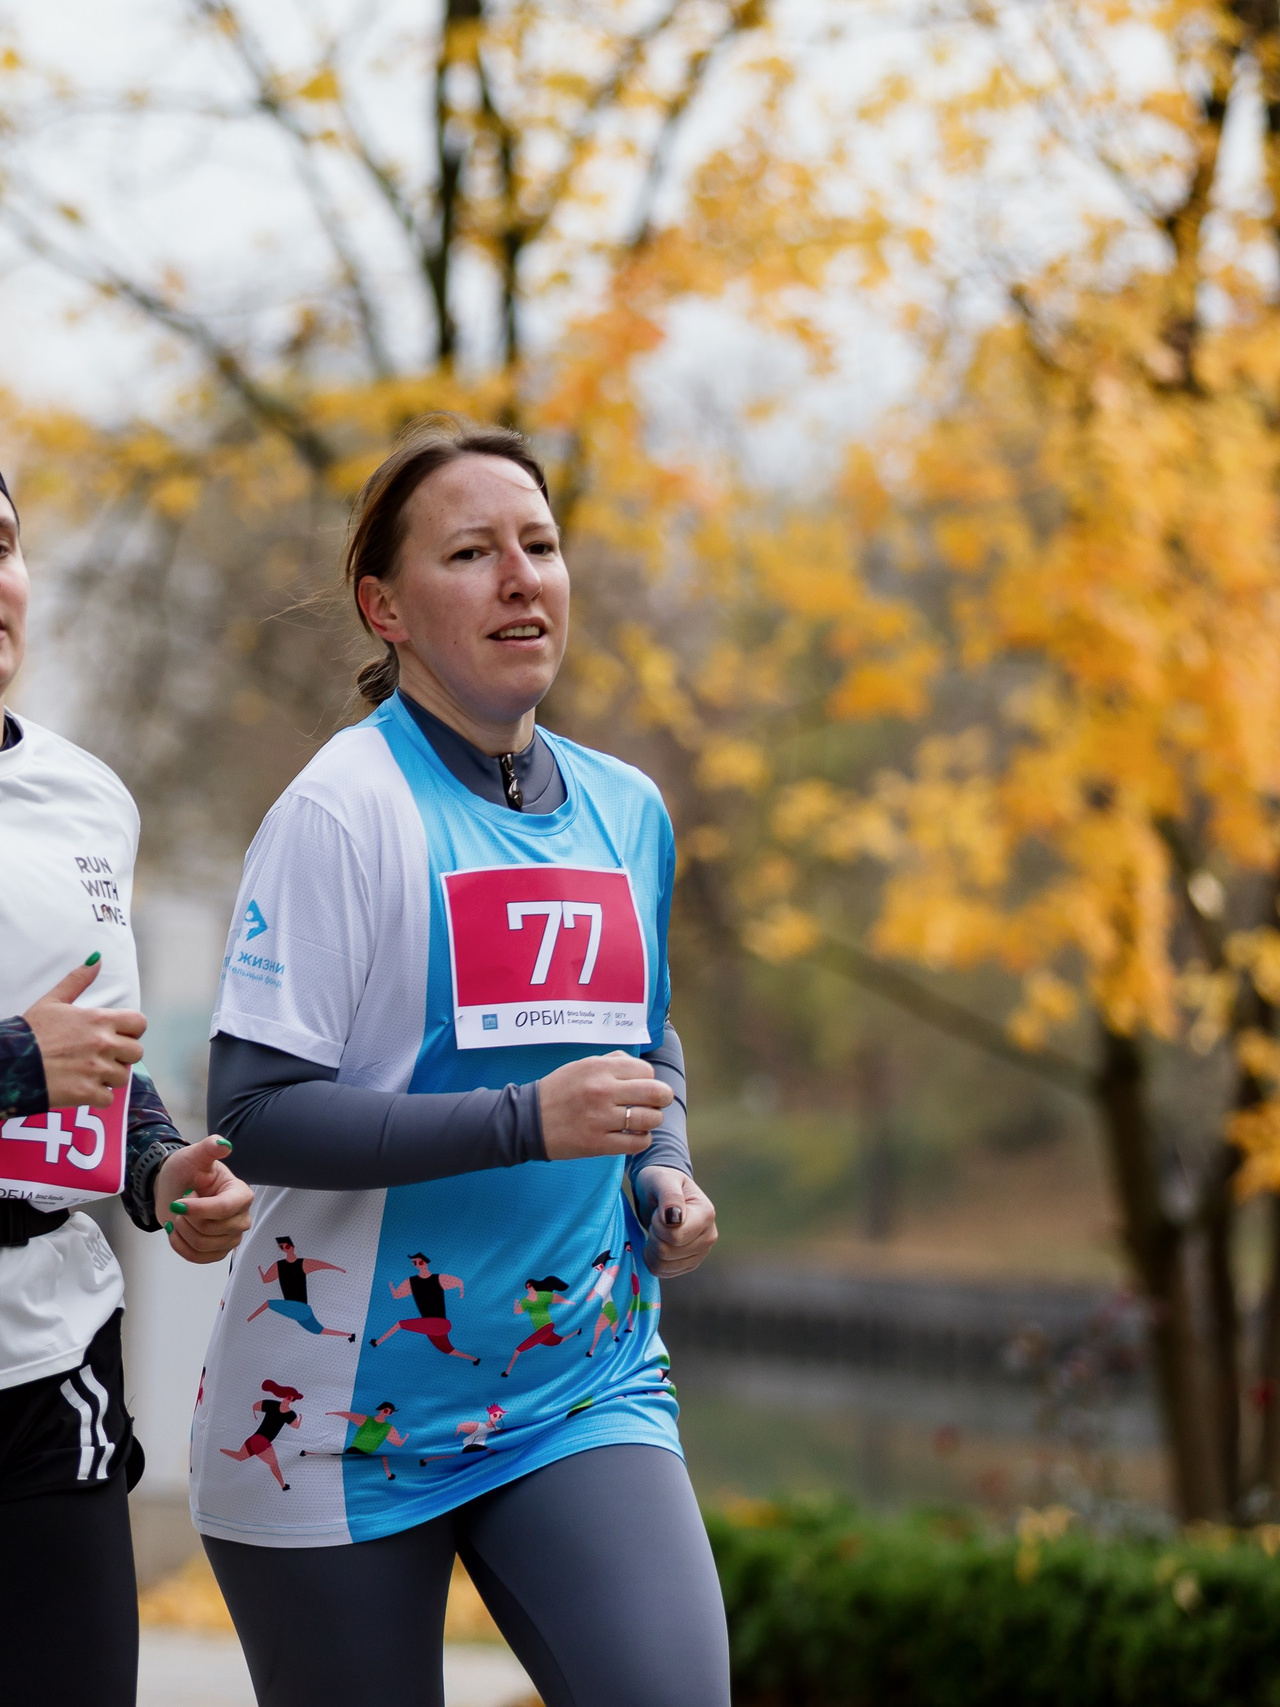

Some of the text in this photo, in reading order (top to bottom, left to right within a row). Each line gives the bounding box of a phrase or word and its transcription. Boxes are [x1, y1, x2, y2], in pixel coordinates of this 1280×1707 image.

[74, 856, 113, 874] RUN
[80, 880, 119, 901] WITH
[506, 900, 602, 985] 77
[237, 951, 285, 975] ЖИЗНИ
[515, 1010, 565, 1027] ОРБИ
